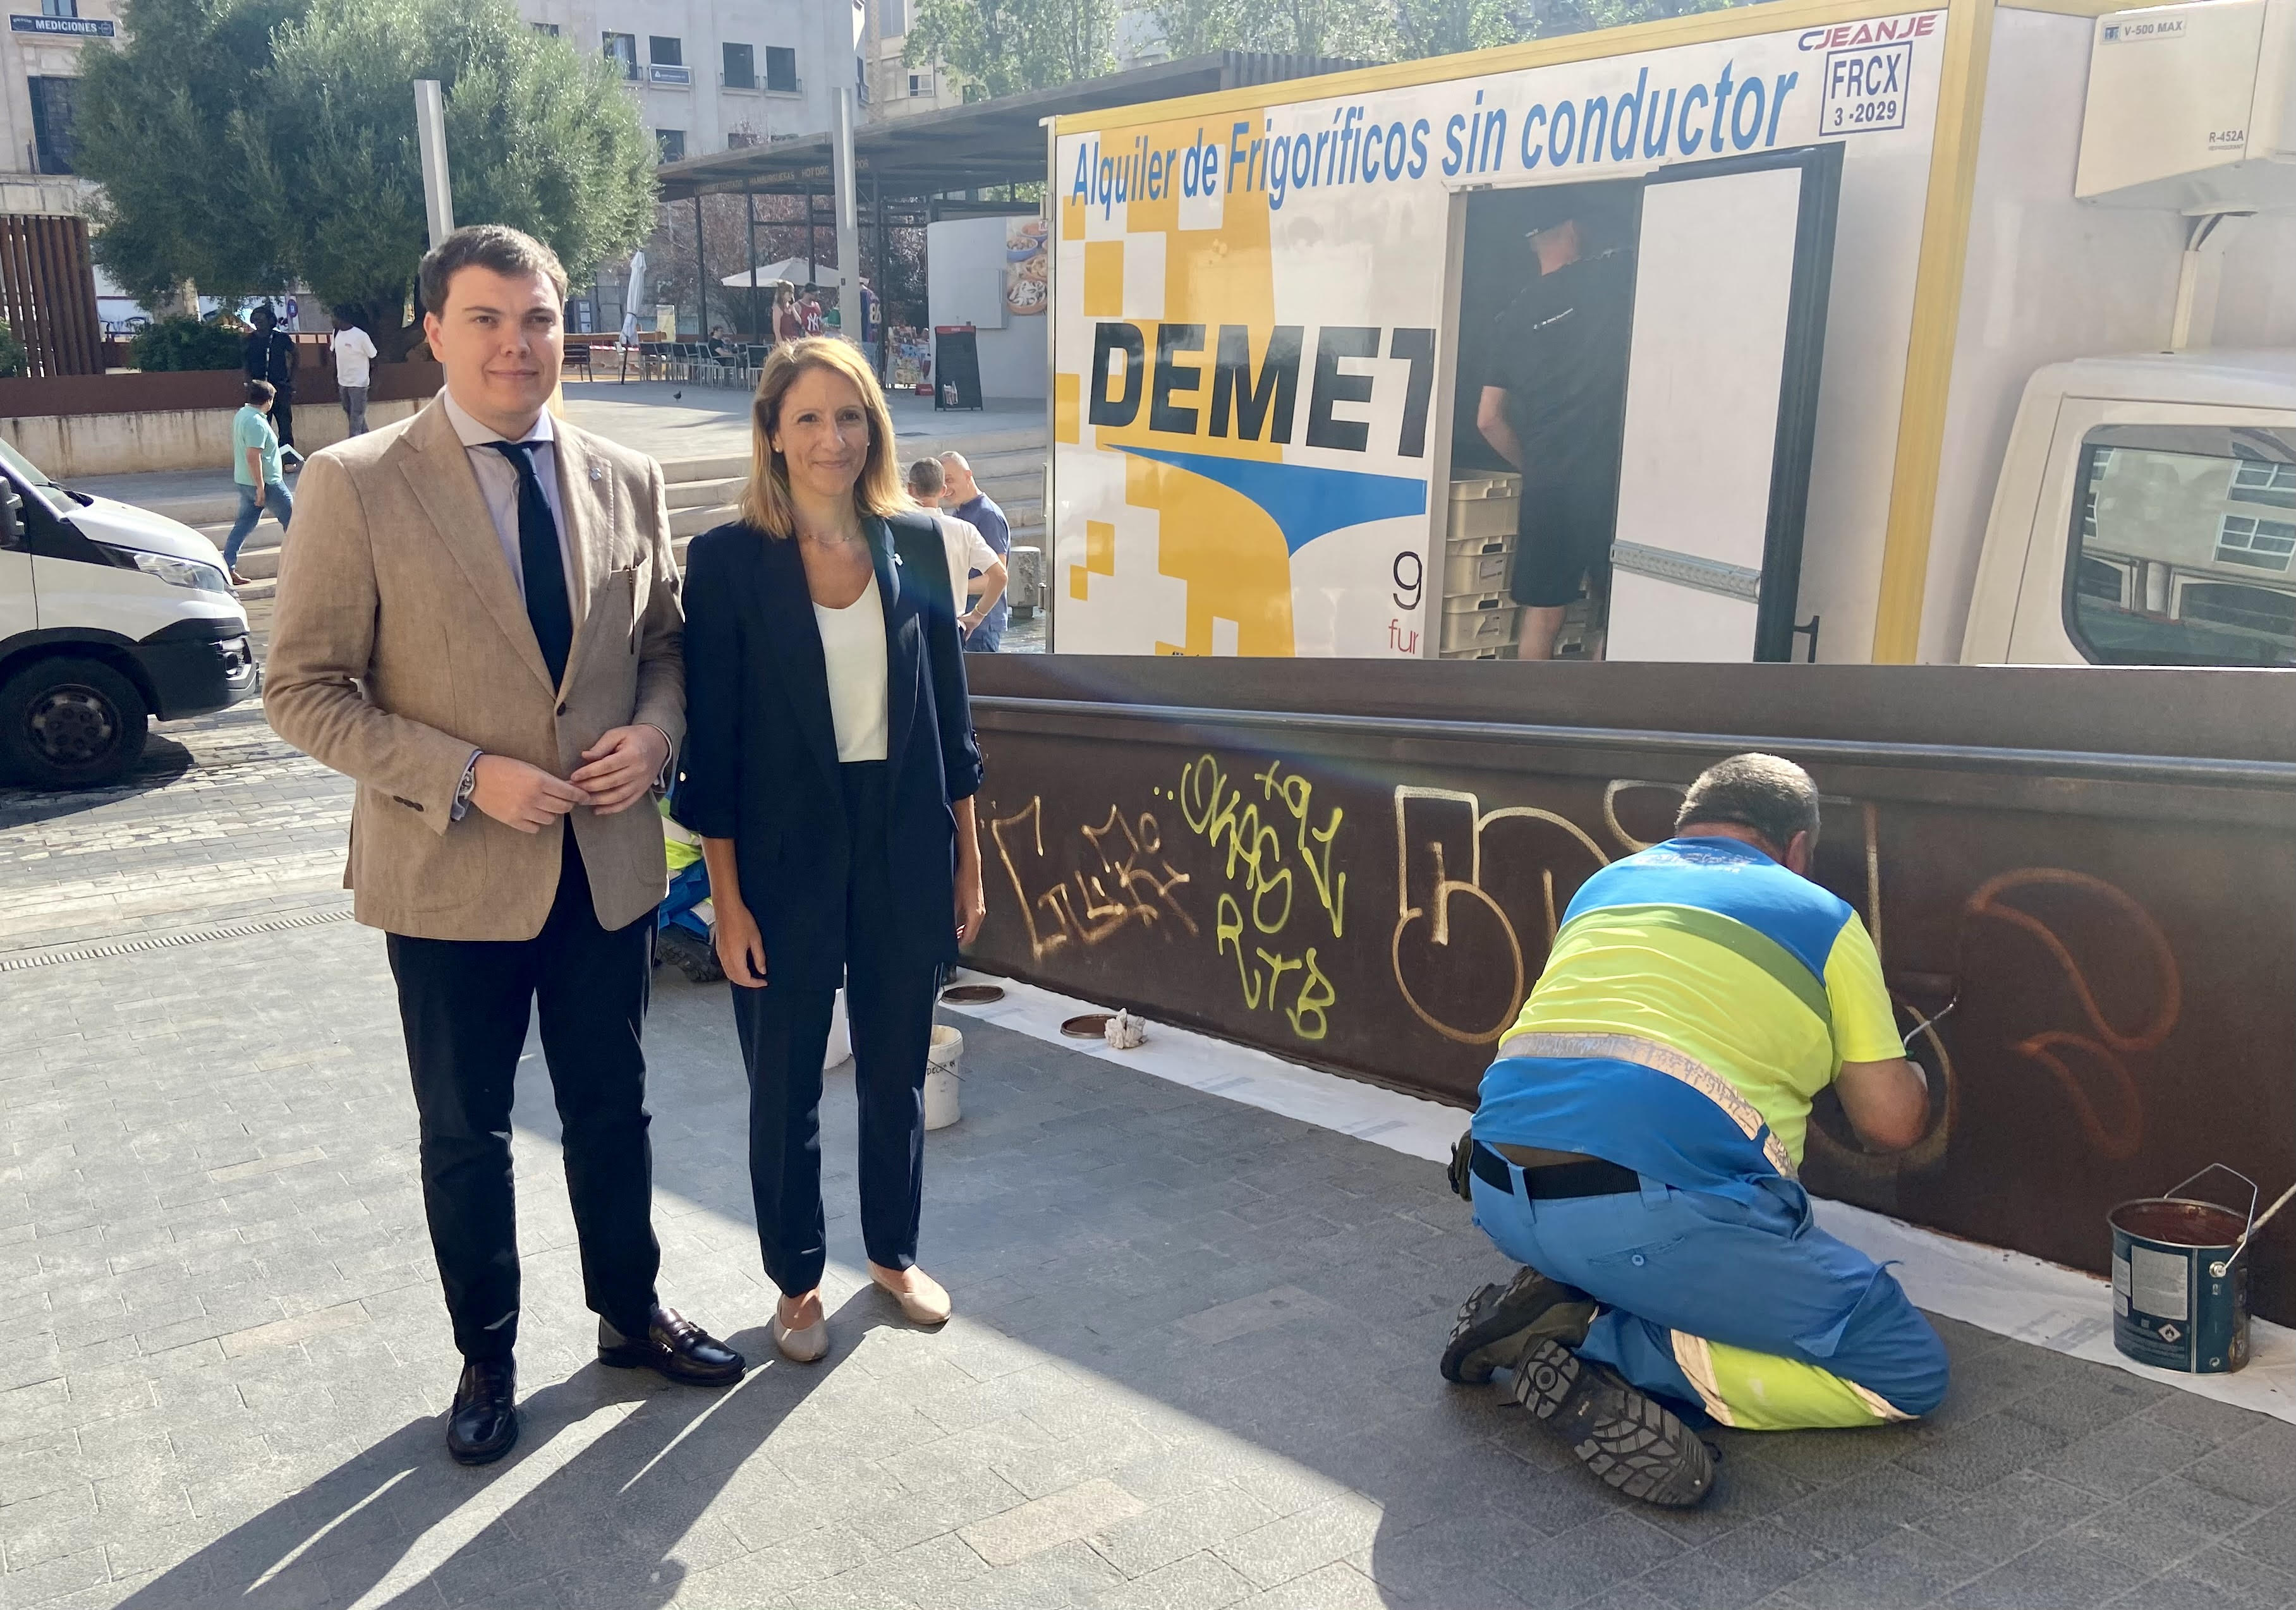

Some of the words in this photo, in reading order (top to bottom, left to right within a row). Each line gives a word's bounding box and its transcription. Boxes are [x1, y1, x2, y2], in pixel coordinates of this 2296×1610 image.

[35, 20, 97, 32] MEDICIONES
[2124, 24, 2154, 36] V-500
[2158, 20, 2183, 32] MAX
[1831, 54, 1902, 99] FRCX
[1834, 107, 1843, 126] 3
[1072, 135, 1176, 221] Alquiler
[1184, 128, 1217, 198] de
[1227, 106, 1431, 211] Frigoríficos
[1441, 89, 1507, 176] sin
[1521, 58, 1799, 170] conductor
[2209, 130, 2244, 142] R-452A
[749, 171, 795, 186] HAMBURGUESAS
[801, 167, 815, 178] HOT
[815, 165, 829, 176] DOG
[1394, 551, 1423, 610] 9
